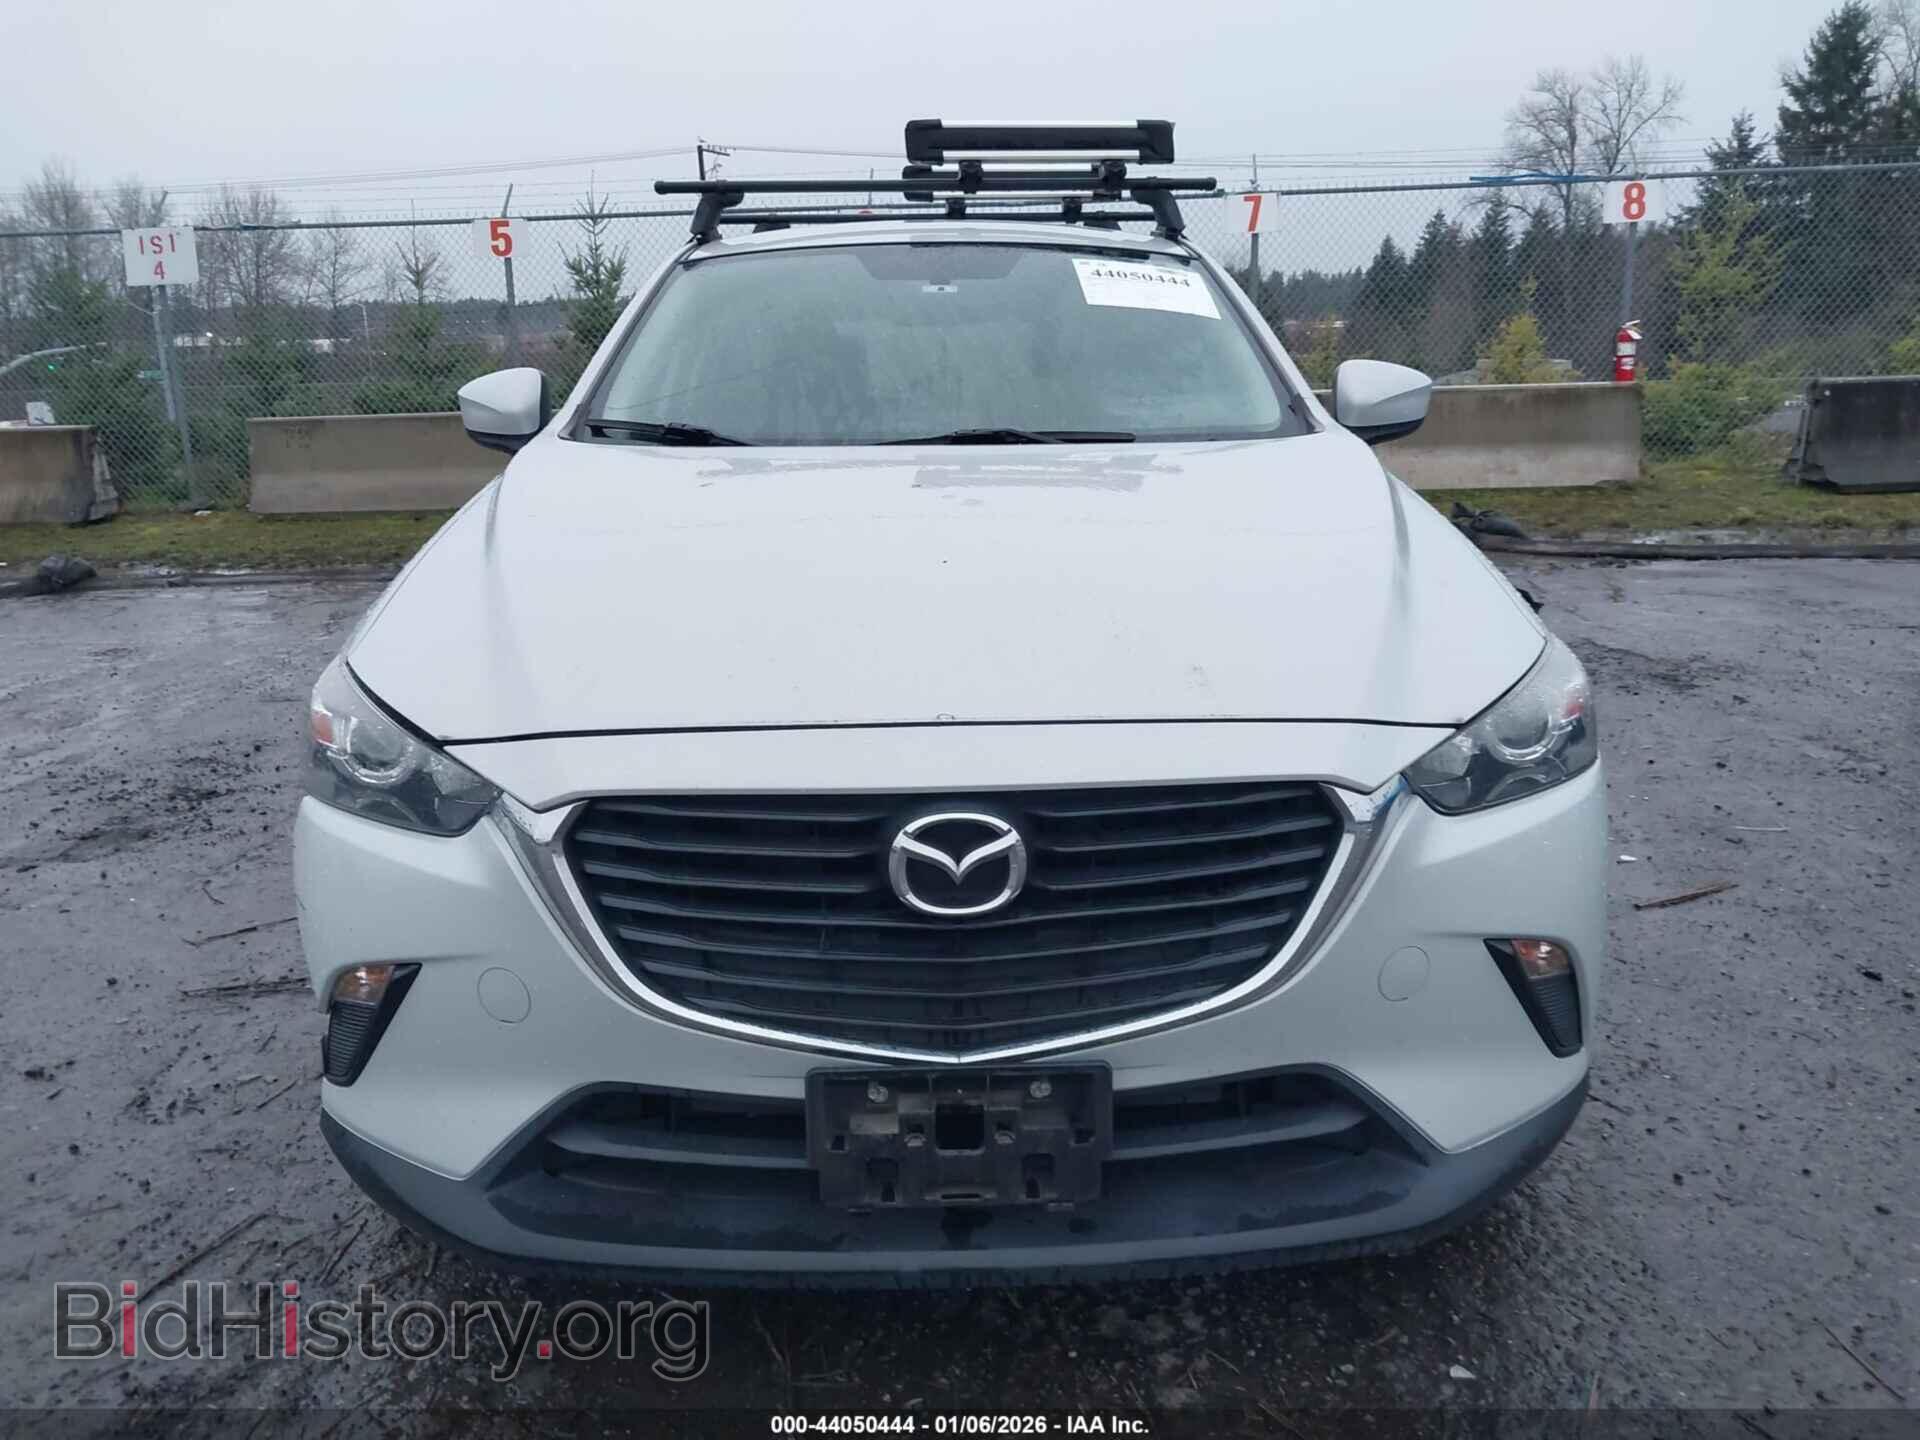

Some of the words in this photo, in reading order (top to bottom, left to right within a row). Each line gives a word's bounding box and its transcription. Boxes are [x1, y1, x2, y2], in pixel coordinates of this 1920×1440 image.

[1243, 195, 1262, 232] 7
[1623, 182, 1646, 220] 8
[490, 220, 512, 257] 5
[153, 260, 166, 280] 4
[1091, 268, 1190, 287] 44050444
